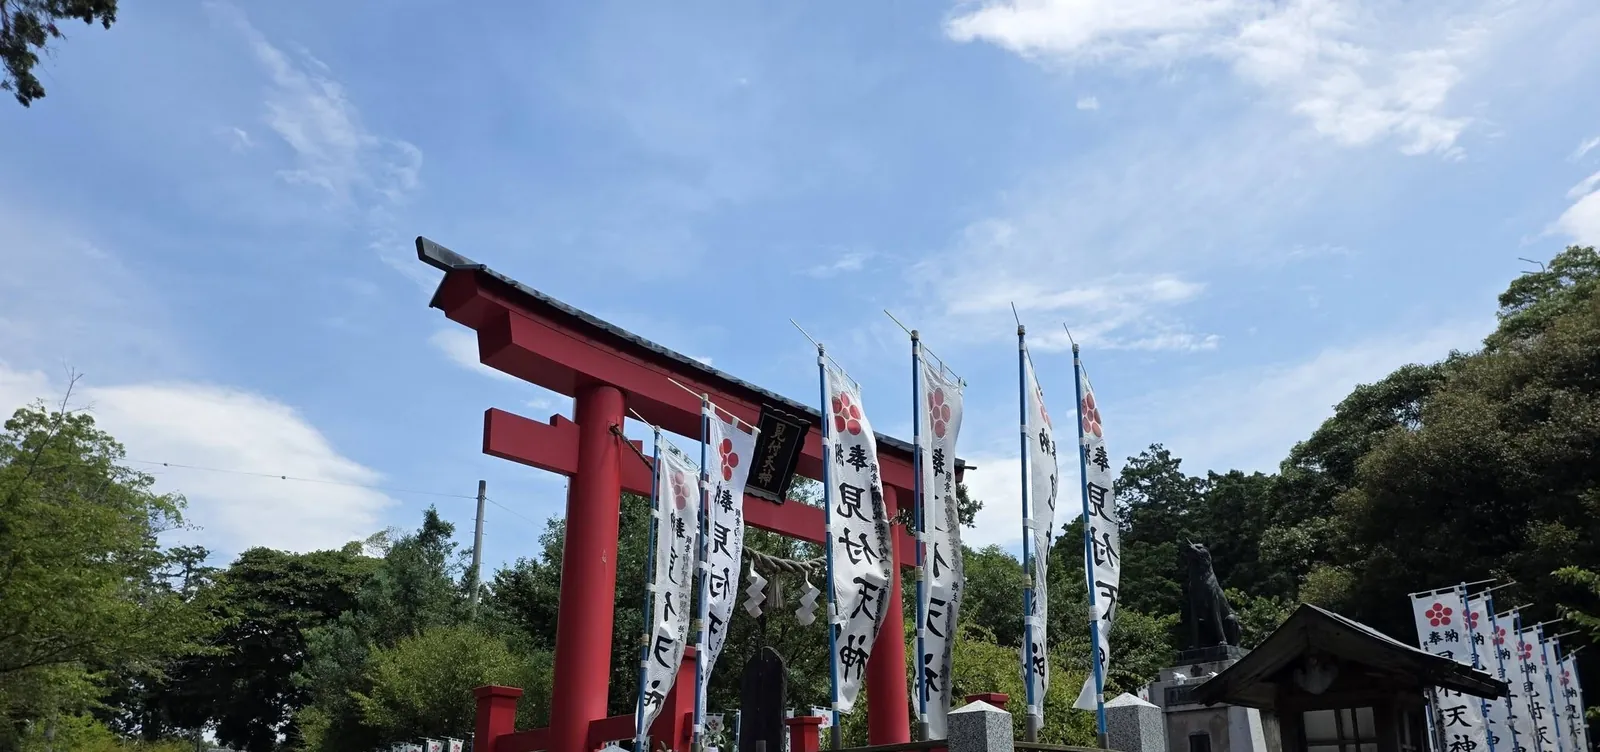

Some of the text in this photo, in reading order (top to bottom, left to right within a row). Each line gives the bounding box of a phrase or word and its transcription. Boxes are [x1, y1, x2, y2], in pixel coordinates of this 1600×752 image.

[758, 422, 786, 487] 見付天神
[1429, 629, 1459, 645] 奉納
[1523, 681, 1552, 752] 見付天
